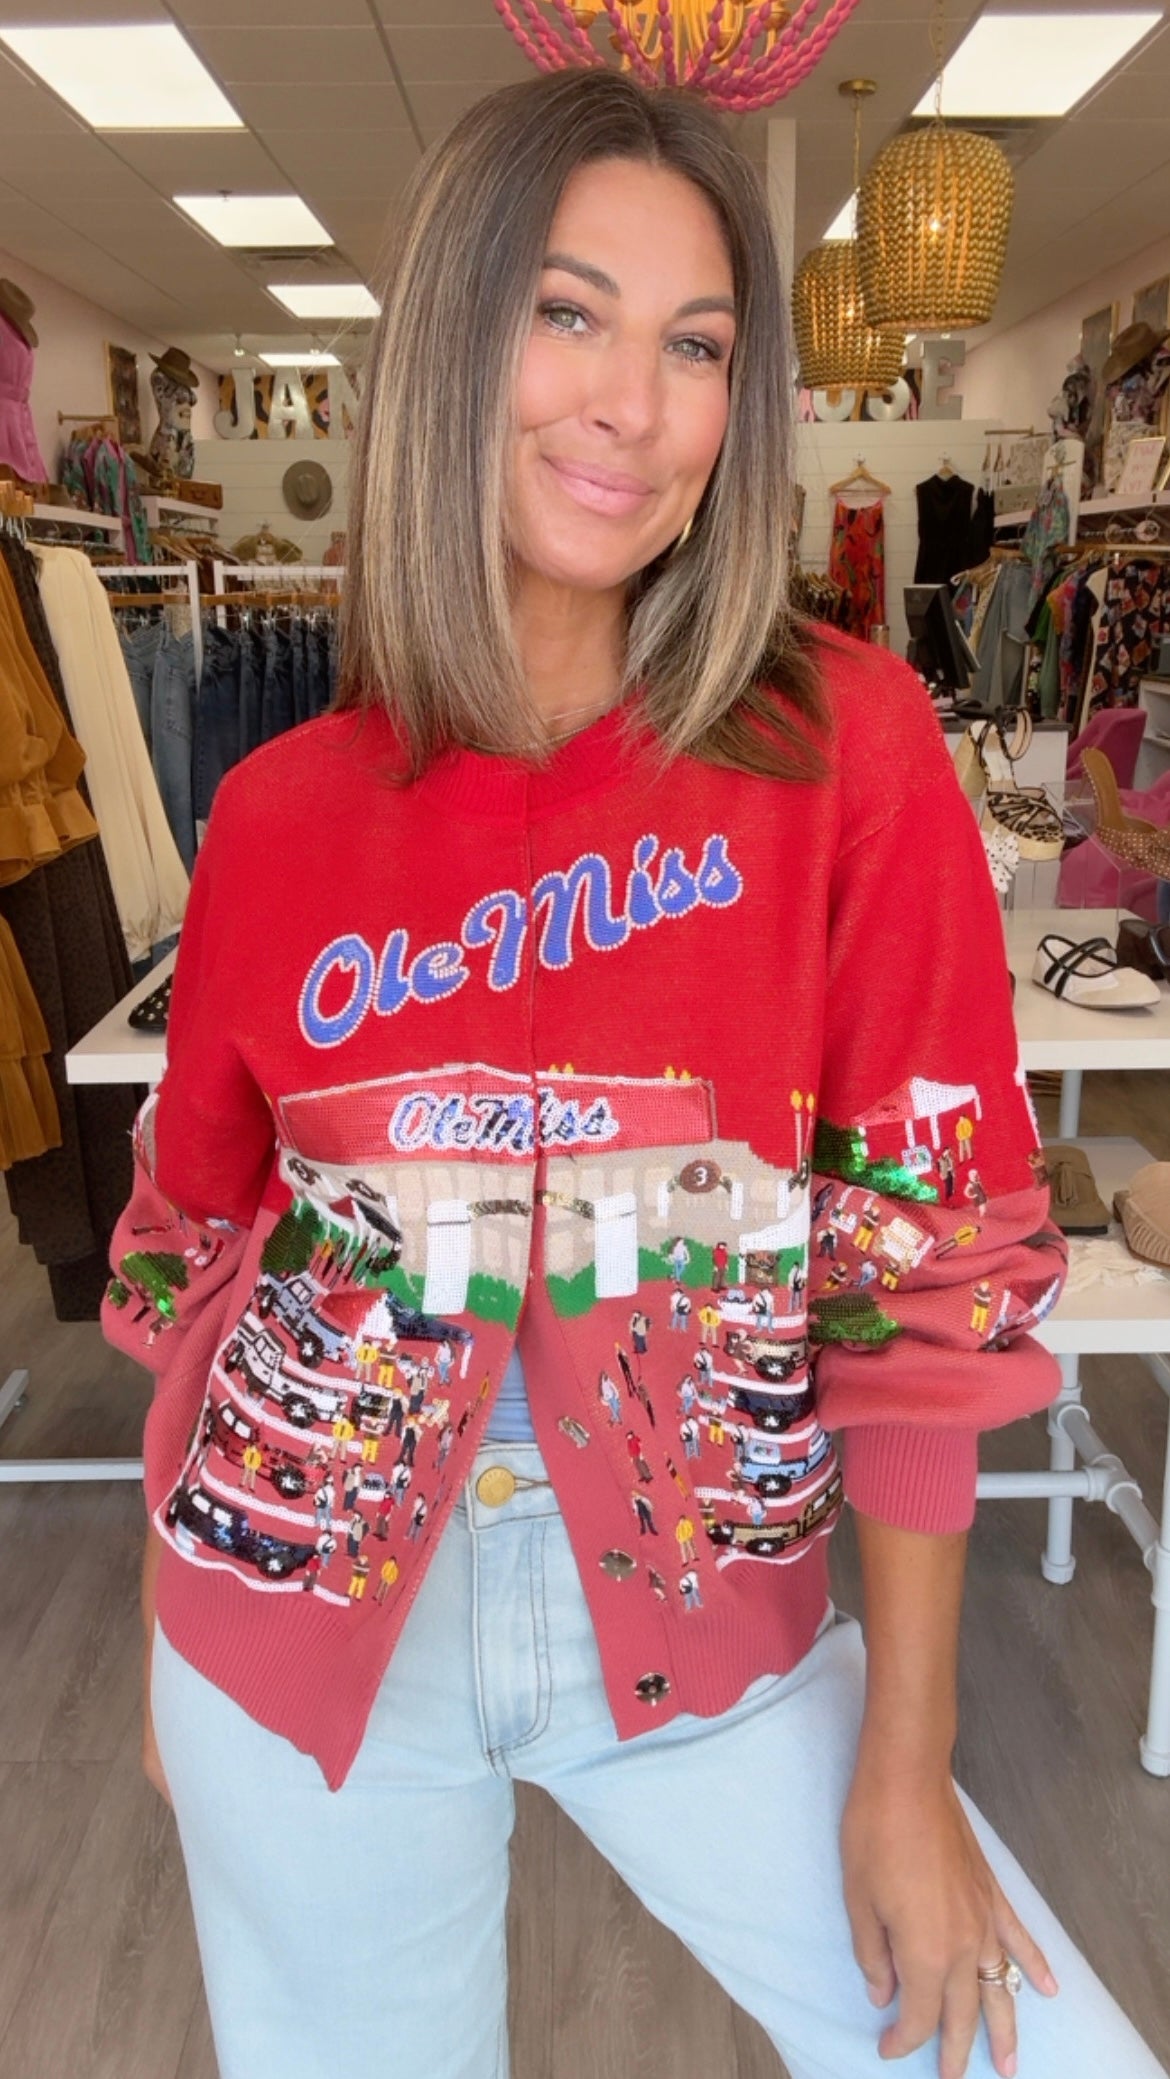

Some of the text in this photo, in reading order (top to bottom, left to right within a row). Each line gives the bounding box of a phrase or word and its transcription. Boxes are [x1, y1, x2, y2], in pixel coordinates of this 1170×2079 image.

[298, 834, 742, 1048] Ole Miss
[389, 1092, 477, 1151] Ole
[694, 1166, 708, 1186] 3
